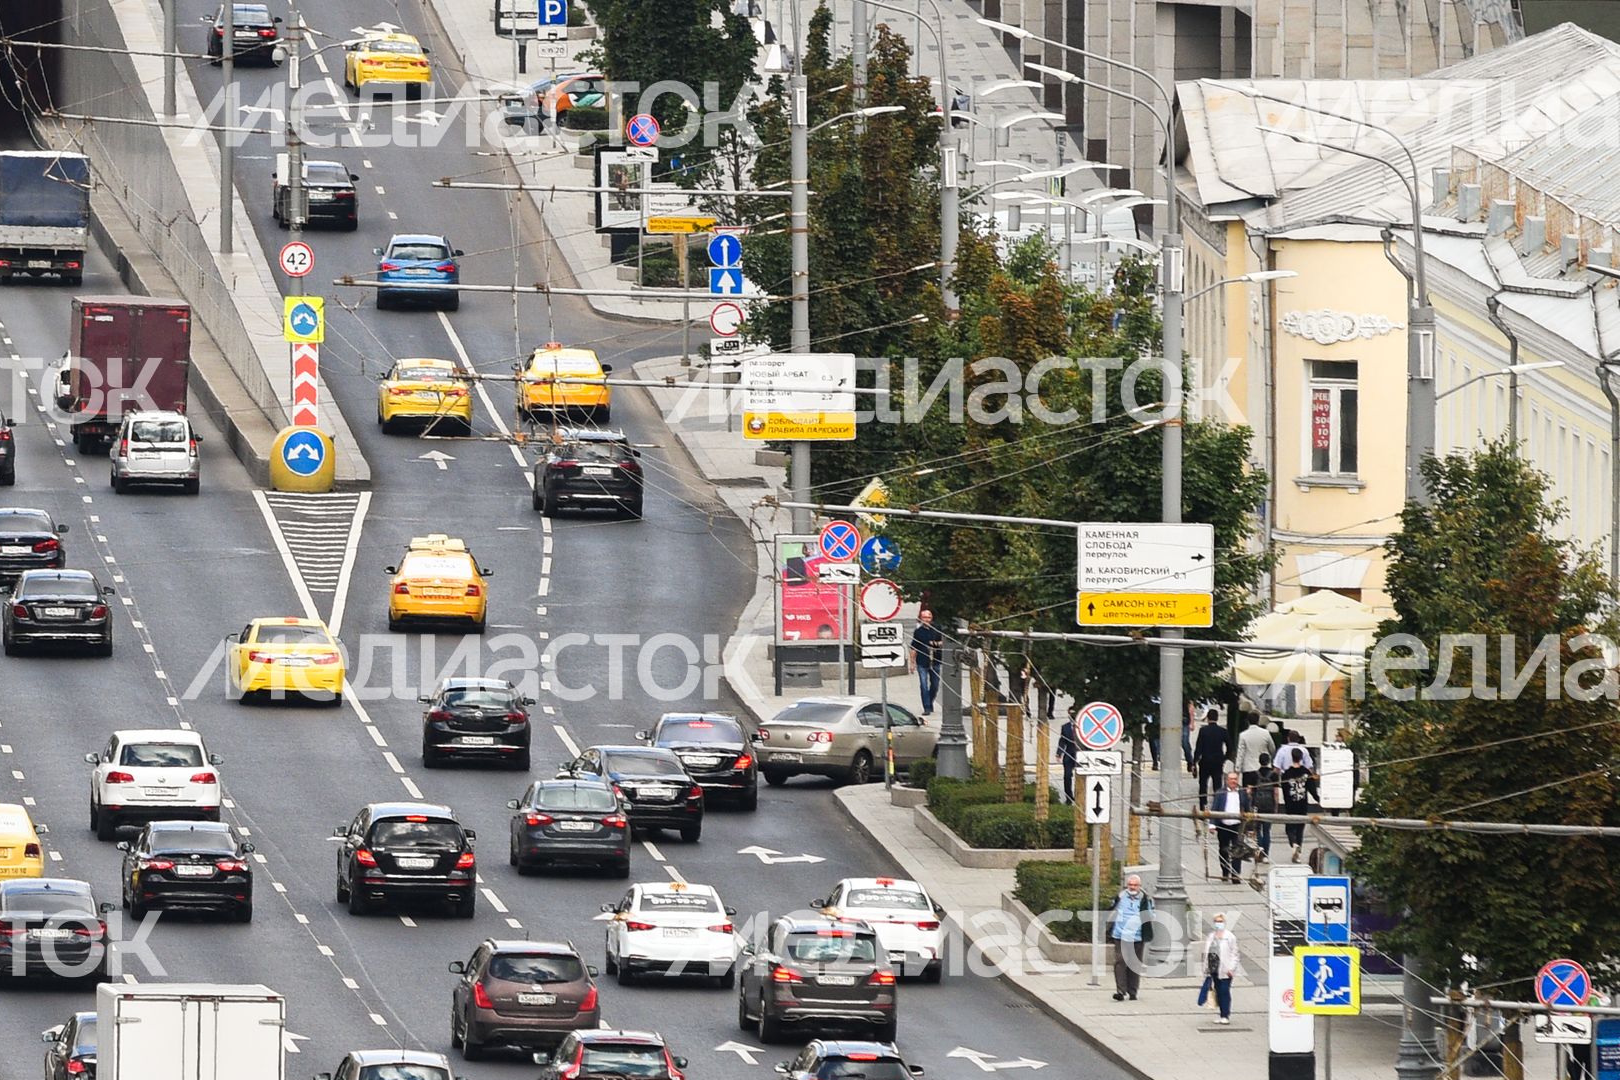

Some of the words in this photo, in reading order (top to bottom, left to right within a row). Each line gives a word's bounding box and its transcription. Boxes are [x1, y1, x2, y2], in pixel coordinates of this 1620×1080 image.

[287, 252, 306, 265] 42
[783, 370, 808, 378] АРБАТ
[768, 426, 804, 434] ПРАВИЛА
[1085, 531, 1139, 539] КАМЕННАЯ
[1085, 542, 1133, 550] СЛОБОДА
[1085, 551, 1128, 560] переулок
[1098, 566, 1170, 575] КАКОВИНСКИЙ
[1085, 577, 1128, 585] переулок
[1102, 600, 1144, 608] САМСОН
[1147, 600, 1178, 608] БУКЕТ
[1102, 612, 1154, 620] цветочный
